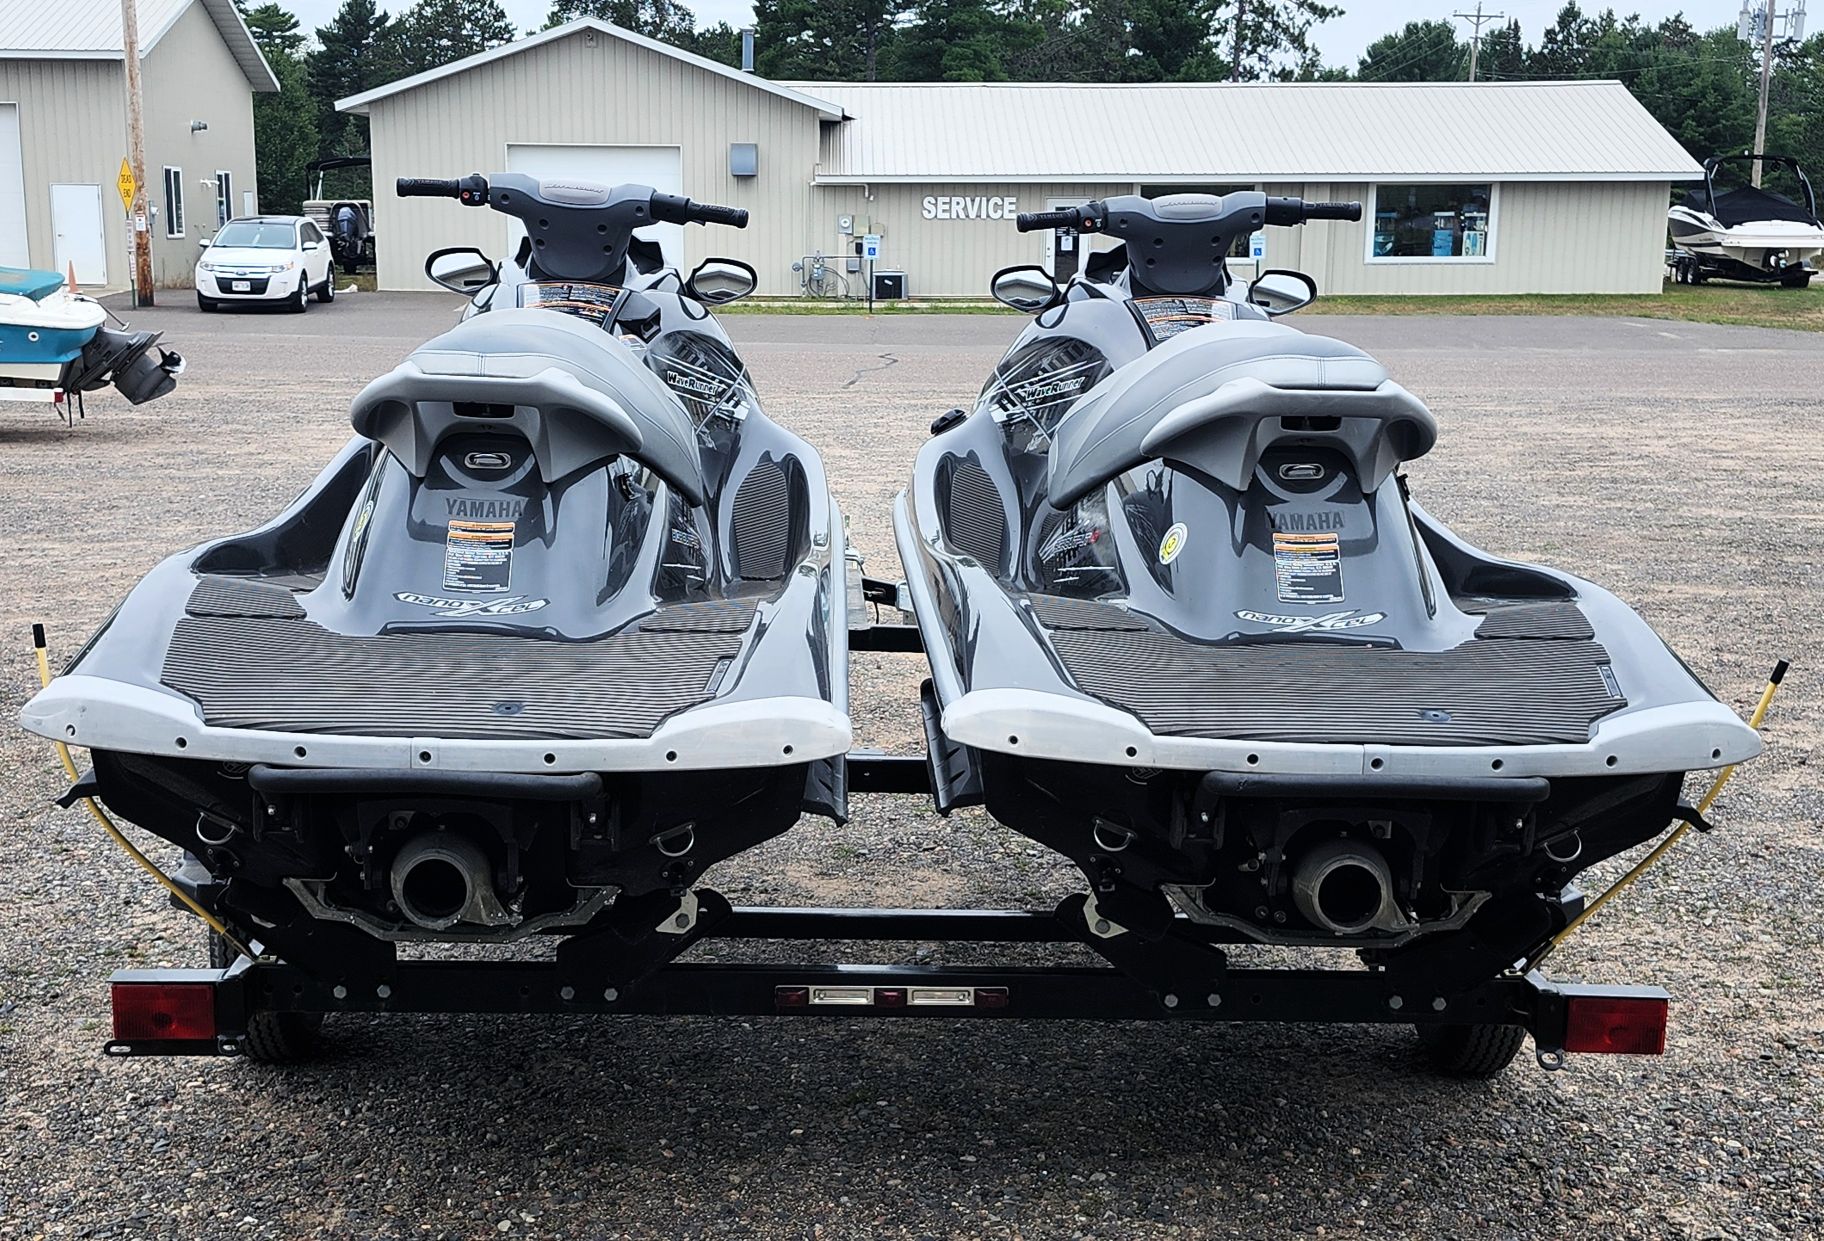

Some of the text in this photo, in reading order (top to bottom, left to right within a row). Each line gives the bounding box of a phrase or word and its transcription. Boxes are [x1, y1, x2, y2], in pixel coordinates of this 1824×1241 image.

[120, 175, 132, 184] DEAD
[123, 189, 131, 198] END
[922, 196, 1017, 220] SERVICE
[446, 498, 524, 518] YAMAHA
[1264, 507, 1345, 531] YAMAHA
